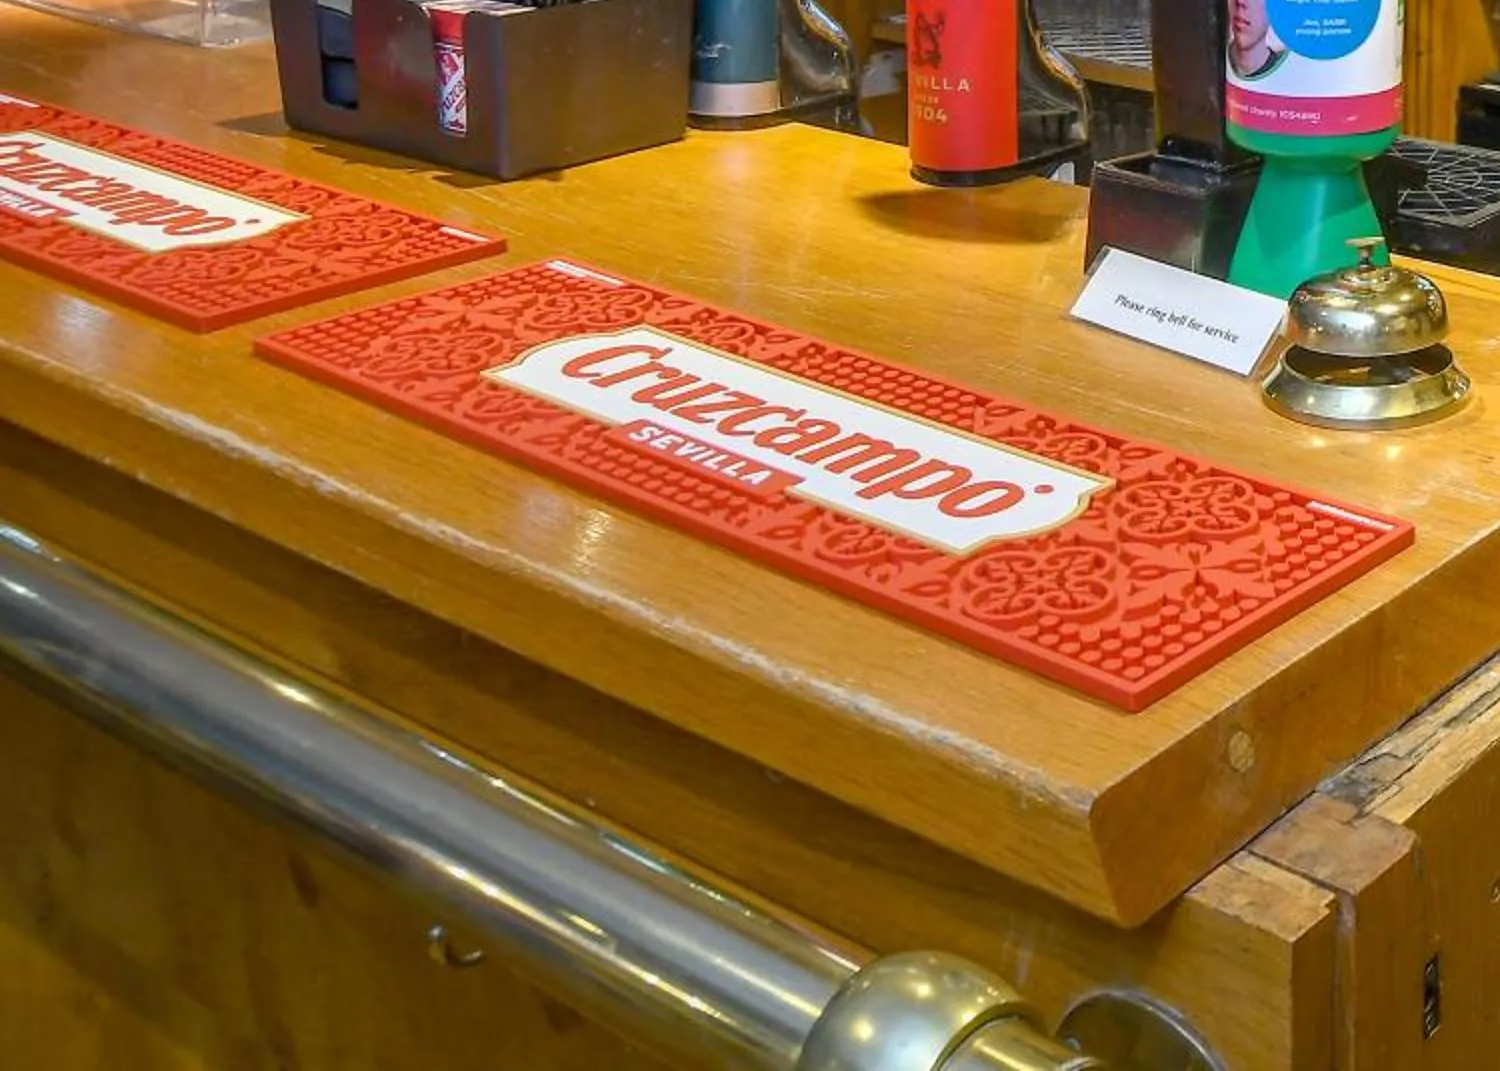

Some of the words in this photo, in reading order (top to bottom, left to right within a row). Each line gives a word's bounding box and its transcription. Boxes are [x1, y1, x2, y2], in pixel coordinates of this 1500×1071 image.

[1114, 294, 1145, 313] Please
[1146, 307, 1167, 323] ring
[1168, 310, 1187, 326] bell
[1204, 326, 1240, 344] service
[561, 343, 1025, 518] Cruzcampo
[627, 425, 773, 485] SEVILLA
